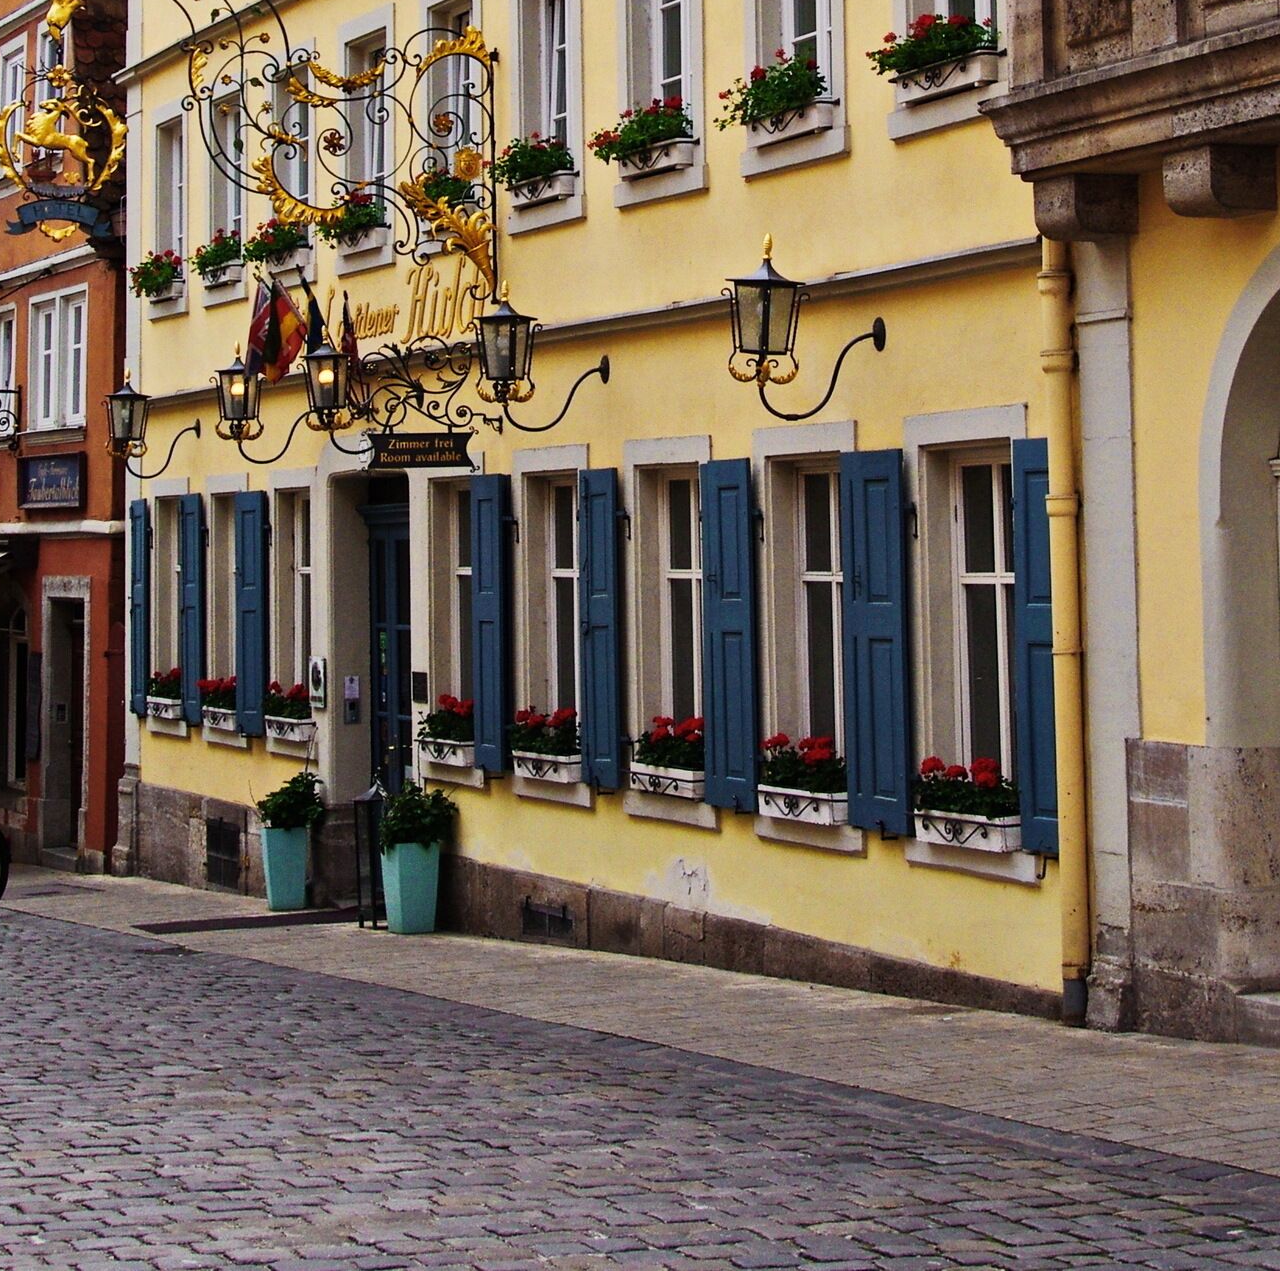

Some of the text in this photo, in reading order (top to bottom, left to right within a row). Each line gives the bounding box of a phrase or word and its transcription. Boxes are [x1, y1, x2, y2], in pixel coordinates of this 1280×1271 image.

[32, 202, 84, 218] HOTEL
[388, 438, 454, 449] Zimmer frei
[380, 451, 462, 463] Room available
